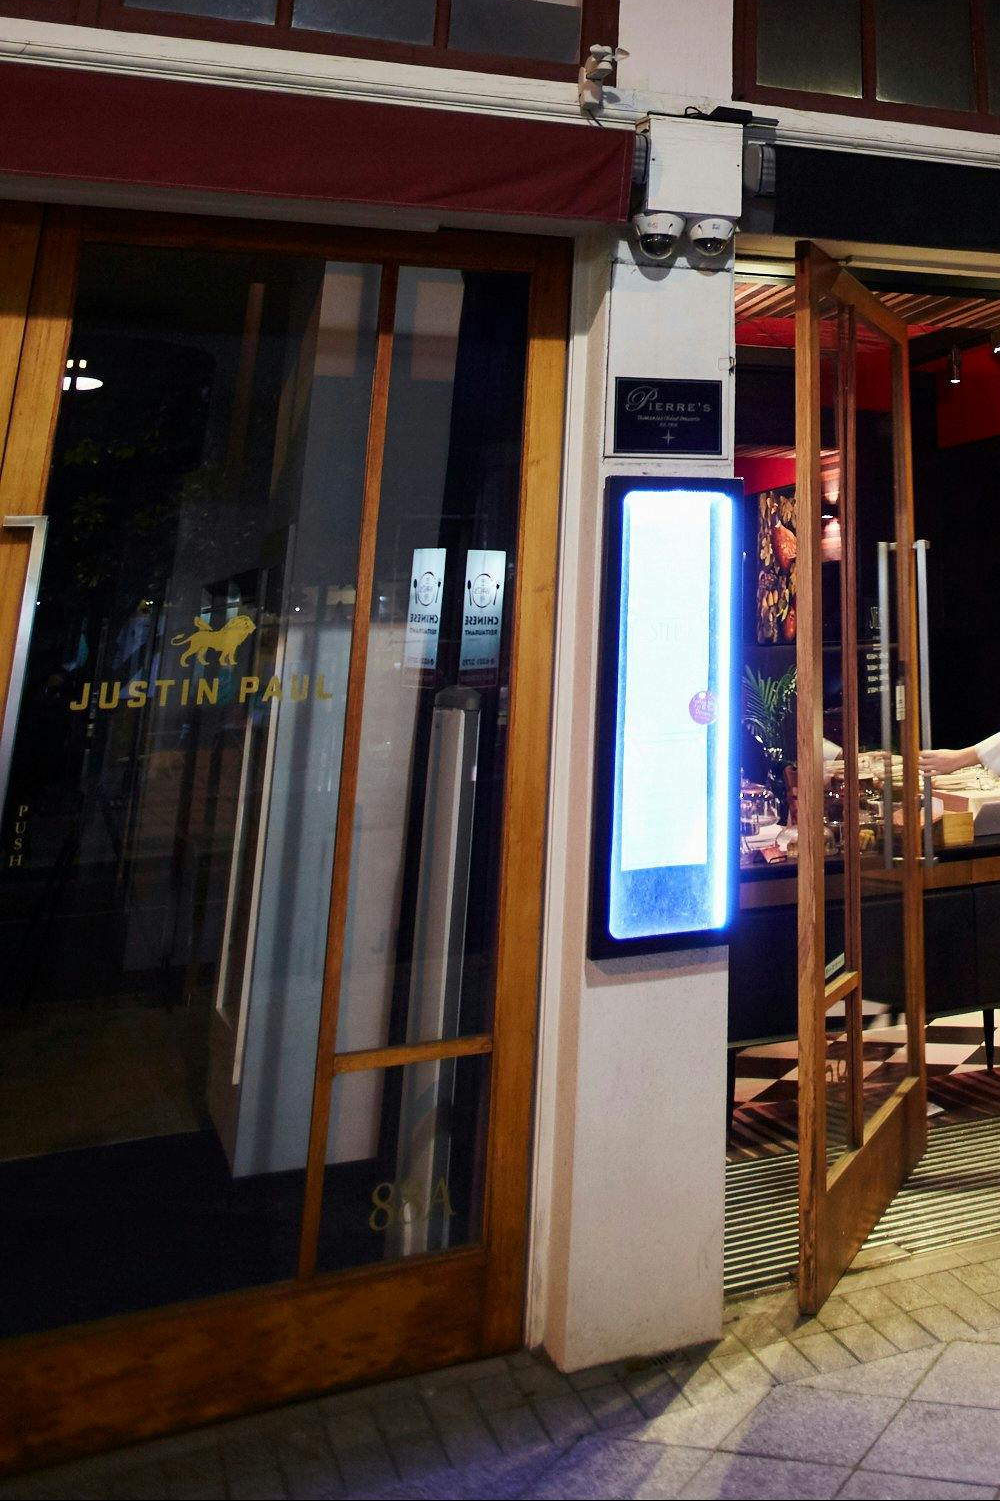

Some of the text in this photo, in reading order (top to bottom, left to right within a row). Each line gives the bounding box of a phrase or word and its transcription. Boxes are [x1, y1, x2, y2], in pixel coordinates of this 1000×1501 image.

[68, 675, 333, 711] JUSTIN PAUL
[9, 804, 29, 867] PUSH
